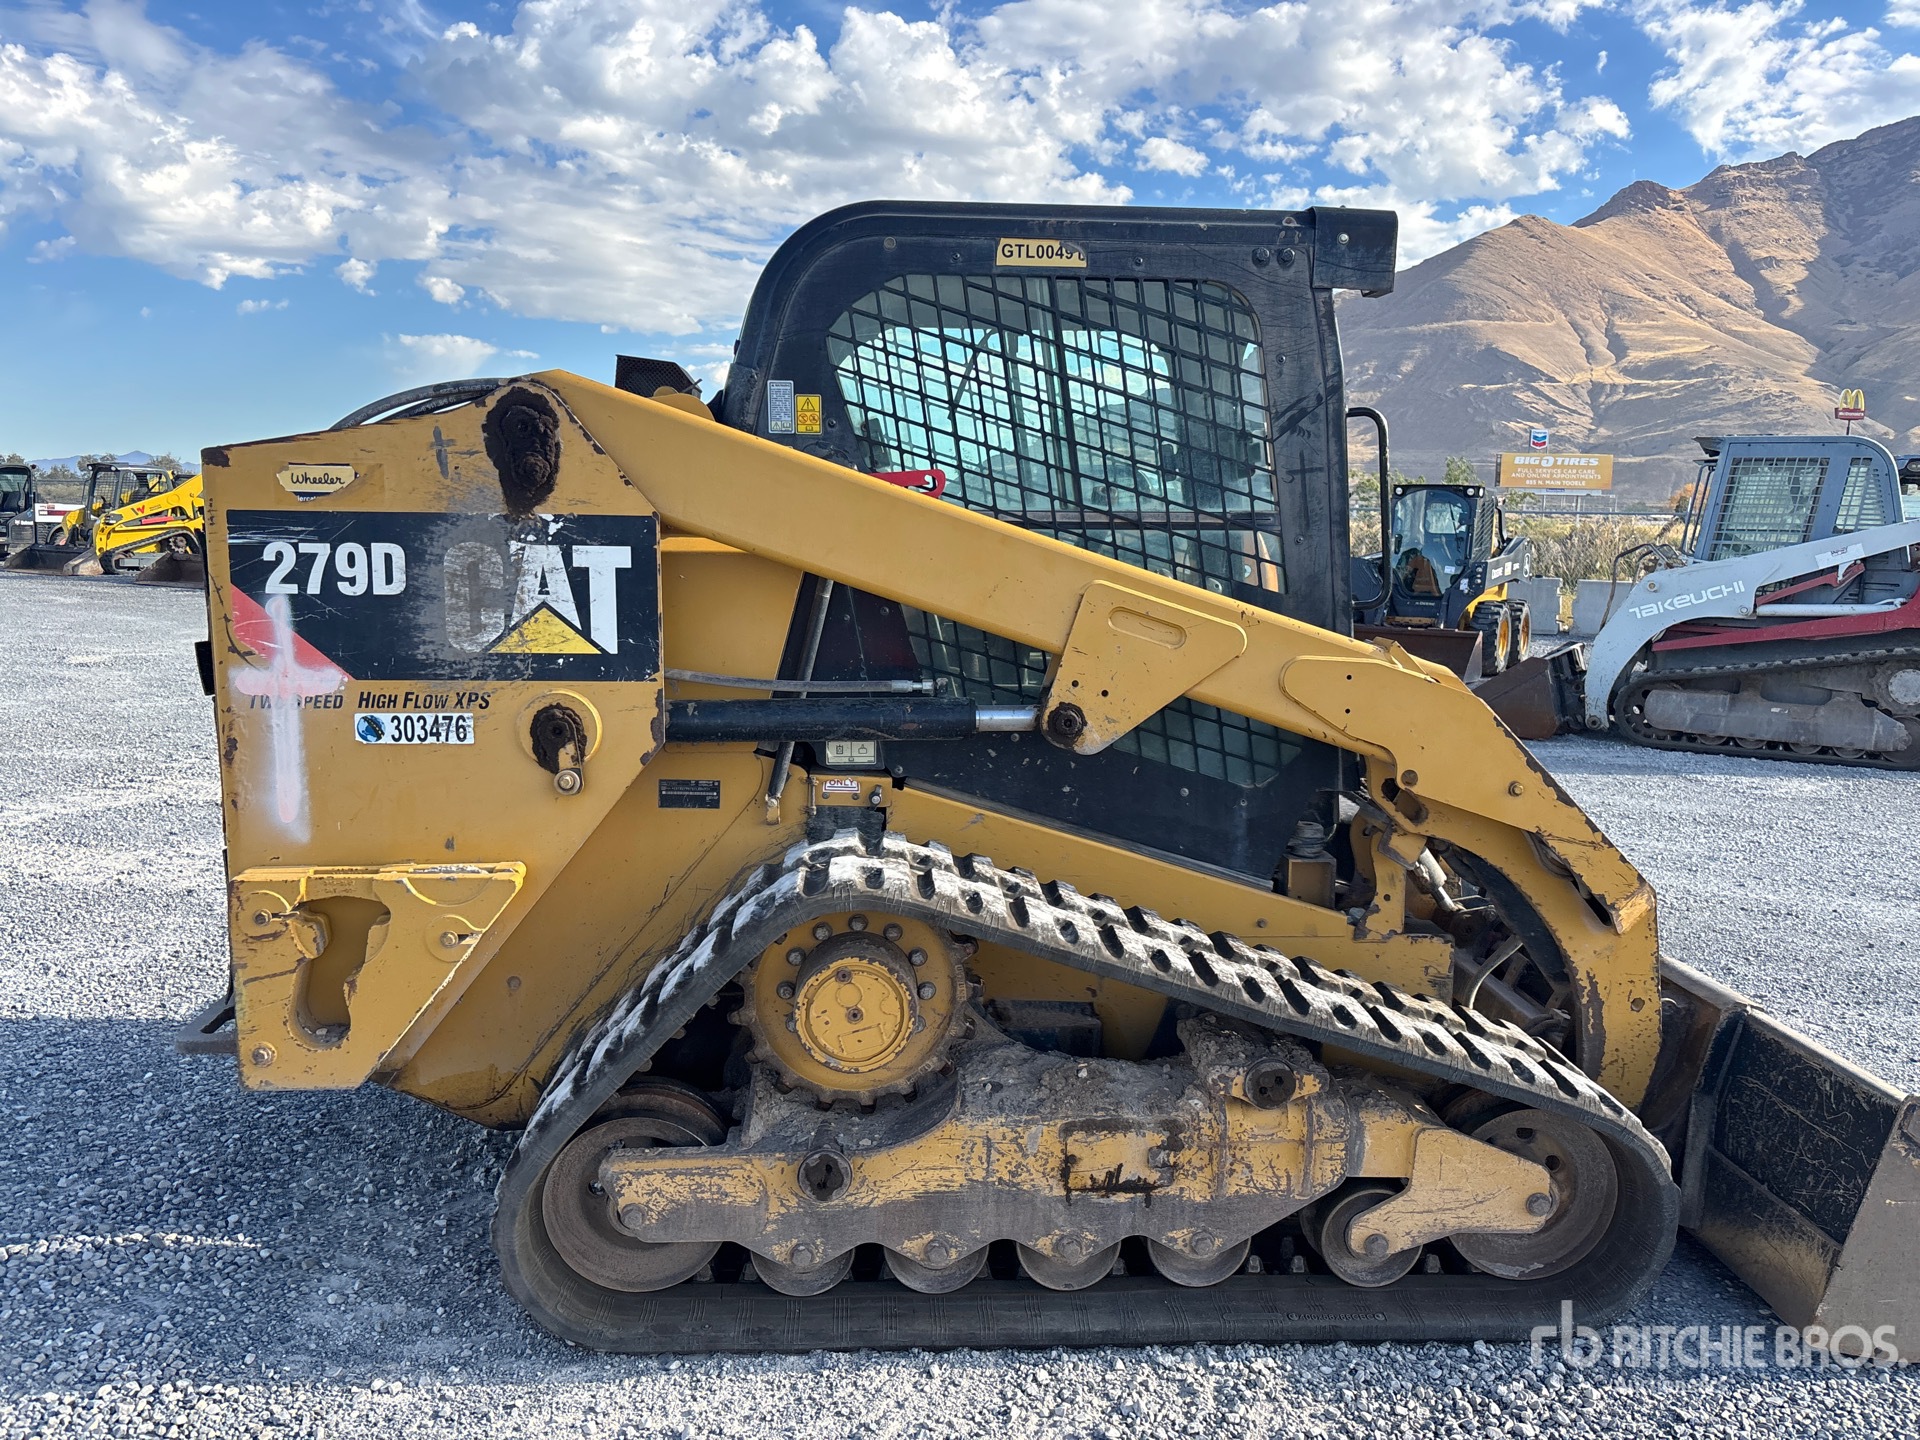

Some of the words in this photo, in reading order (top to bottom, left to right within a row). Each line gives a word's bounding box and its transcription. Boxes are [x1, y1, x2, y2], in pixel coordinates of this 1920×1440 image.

[1514, 456, 1540, 465] BIG
[1555, 457, 1599, 466] TIRES
[290, 472, 345, 485] Wheeler
[262, 541, 406, 597] 279D
[443, 541, 632, 655] CAT
[1628, 580, 1746, 619] TAKEUCHI
[357, 691, 399, 709] HIGH
[402, 691, 448, 709] FLOW
[453, 691, 492, 710] XPS
[390, 714, 468, 743] 303476
[829, 778, 854, 786] ONLY
